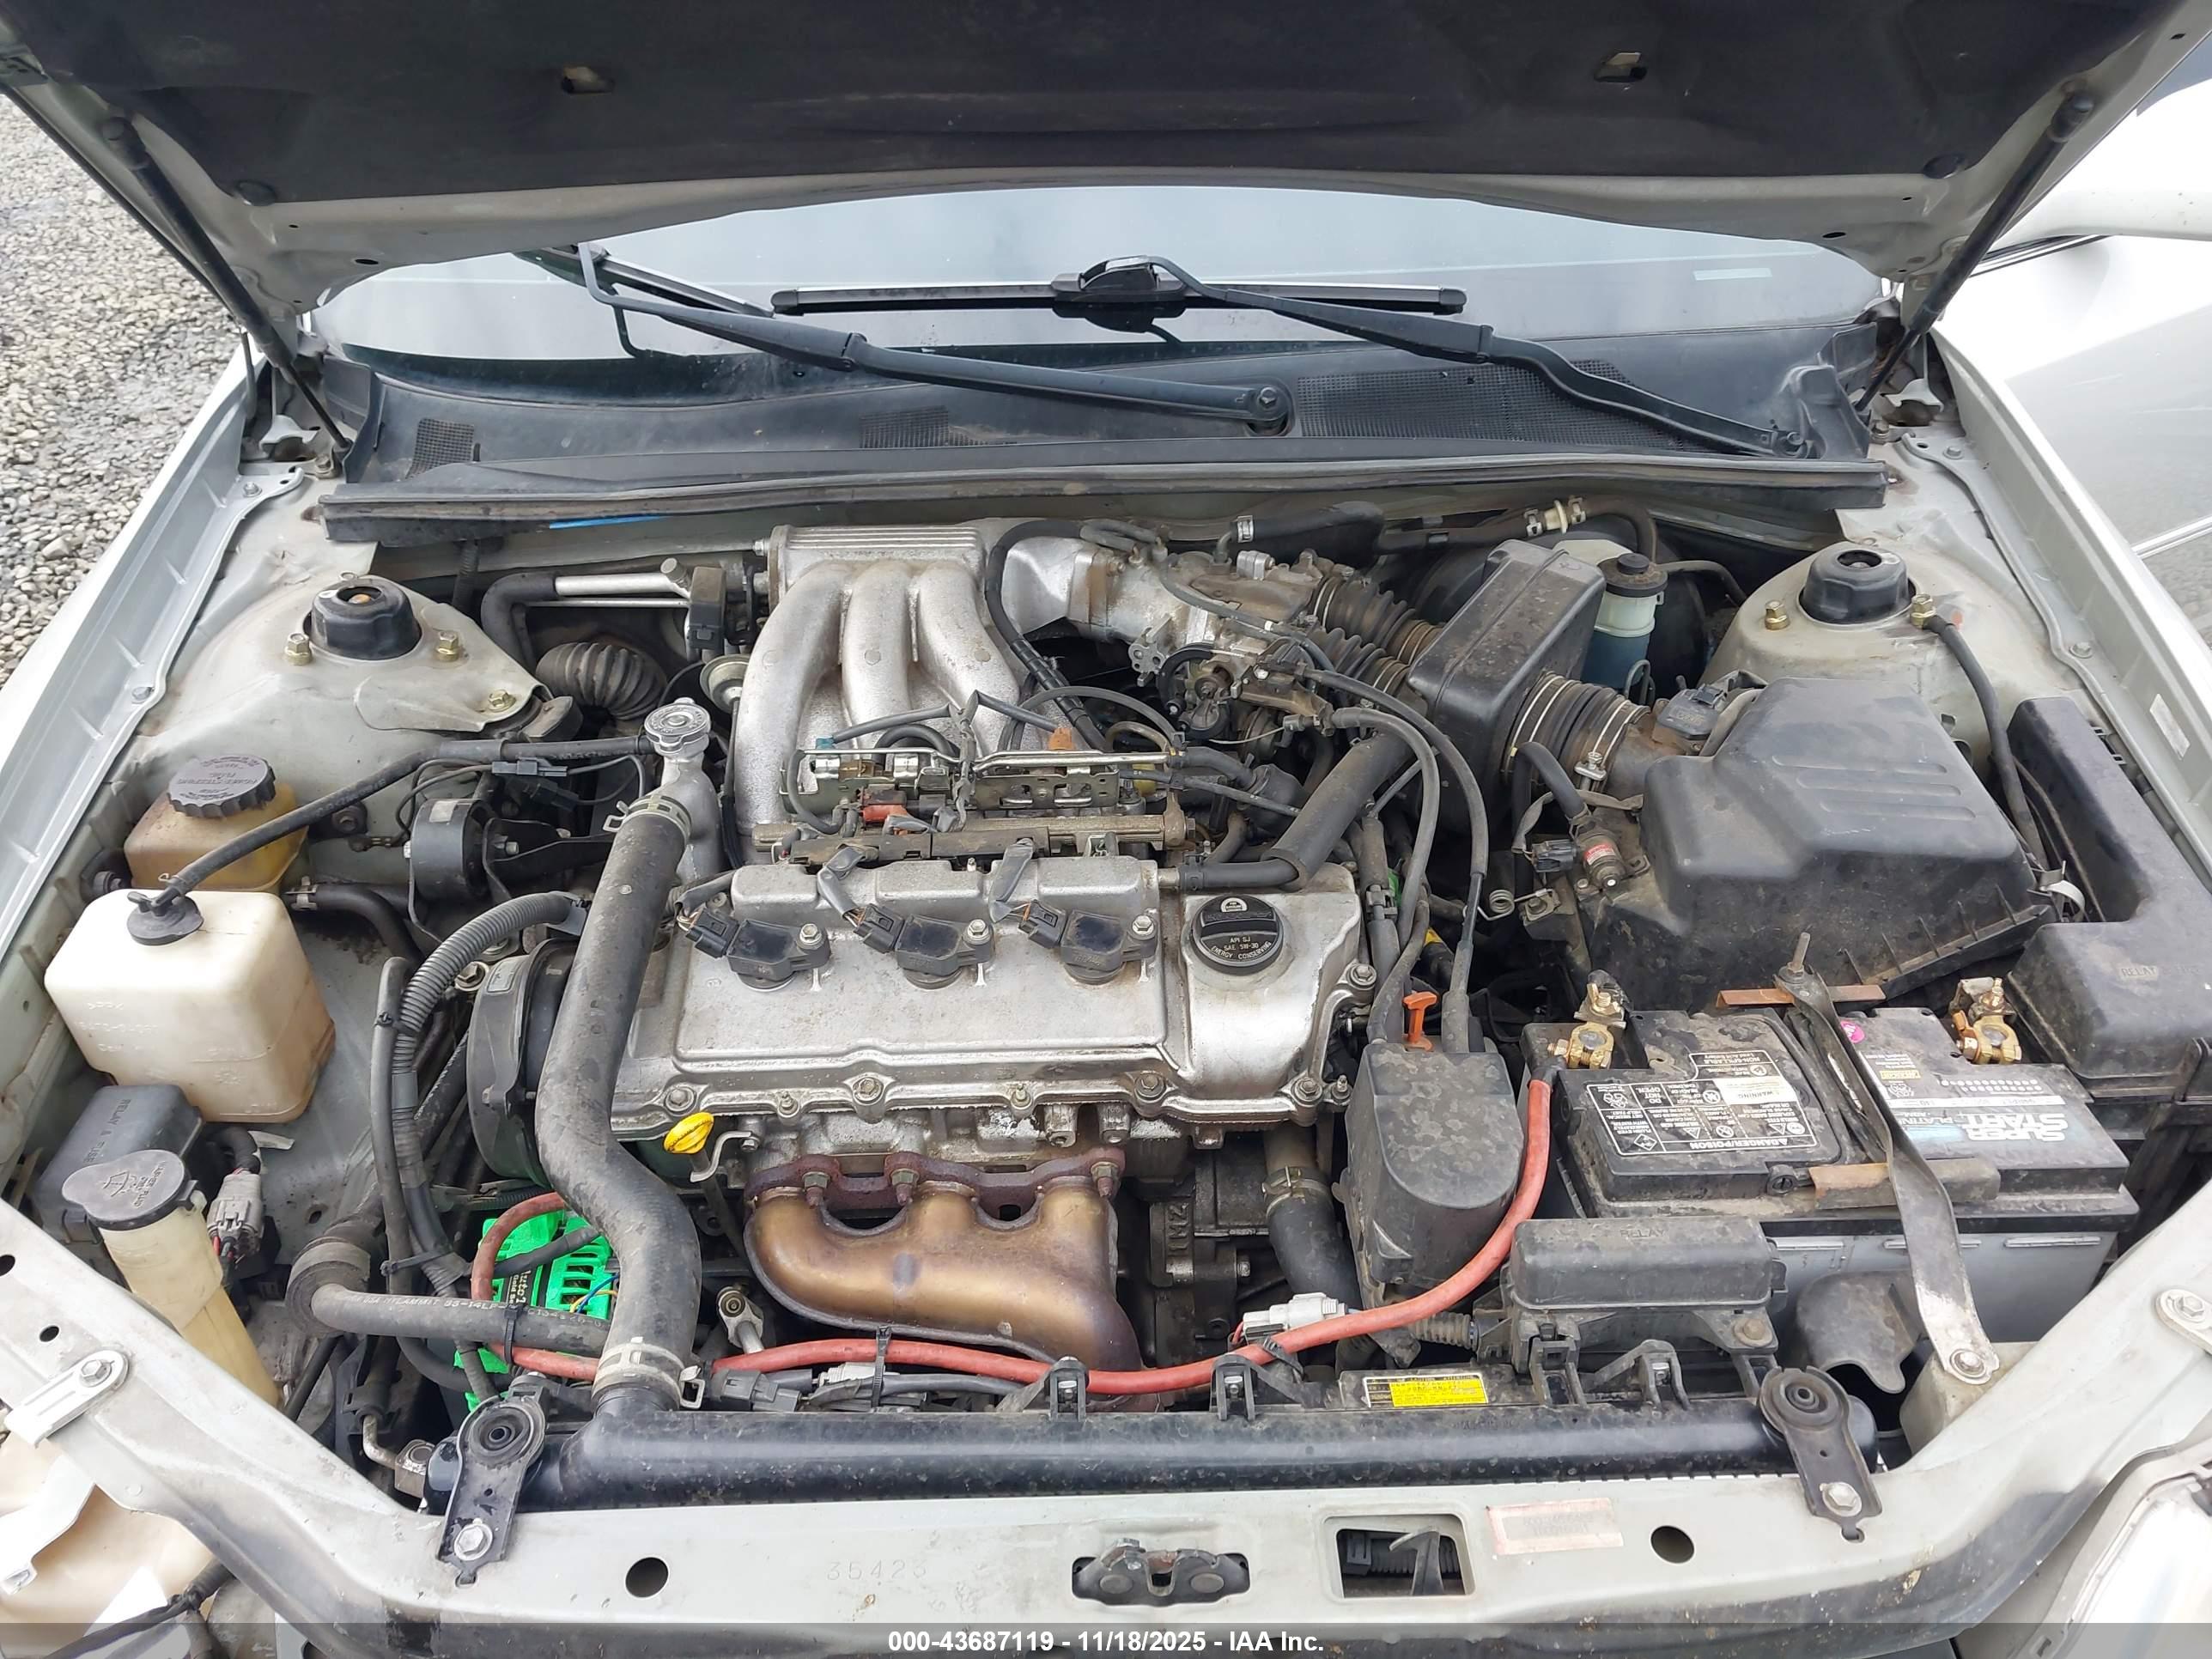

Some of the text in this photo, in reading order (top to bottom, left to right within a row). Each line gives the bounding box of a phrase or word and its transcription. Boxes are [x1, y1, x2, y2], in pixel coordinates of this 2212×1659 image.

[1211, 945, 1234, 959] ENERGY
[107, 1098, 131, 1127] RELAY
[1963, 1113, 2069, 1130] START
[1966, 1127, 2065, 1141] SUPER
[1690, 1139, 1779, 1149] DANGER/POISON
[1620, 1228, 1666, 1238] RELAY
